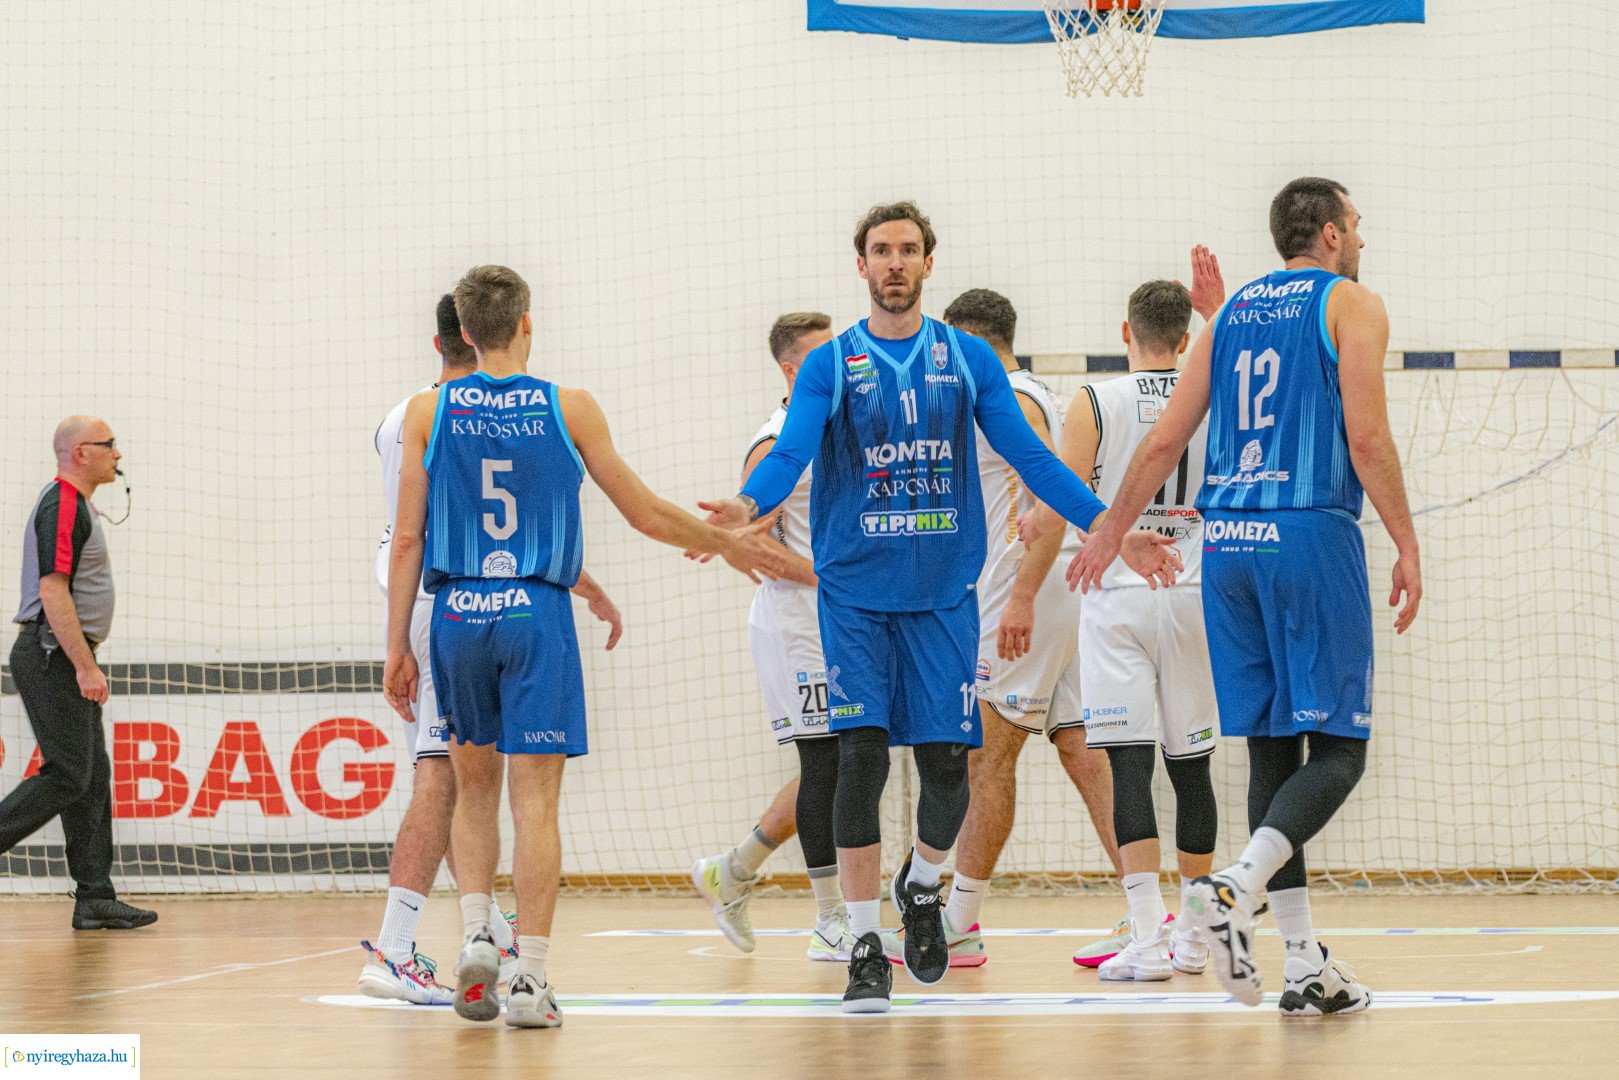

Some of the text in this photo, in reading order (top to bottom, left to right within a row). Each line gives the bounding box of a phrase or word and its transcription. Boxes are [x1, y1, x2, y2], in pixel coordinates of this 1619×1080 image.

[1237, 279, 1315, 301] KOMETA
[924, 374, 959, 383] KOMETA
[1235, 347, 1281, 430] 12
[449, 387, 548, 410] KOMETA
[900, 388, 918, 425] 11
[864, 440, 953, 468] KOMETA
[481, 458, 518, 541] 5
[1205, 521, 1281, 543] KOMETA
[446, 587, 532, 612] KOMETA
[798, 683, 829, 714] 20
[959, 681, 976, 717] 11
[0, 717, 396, 819] BAG
